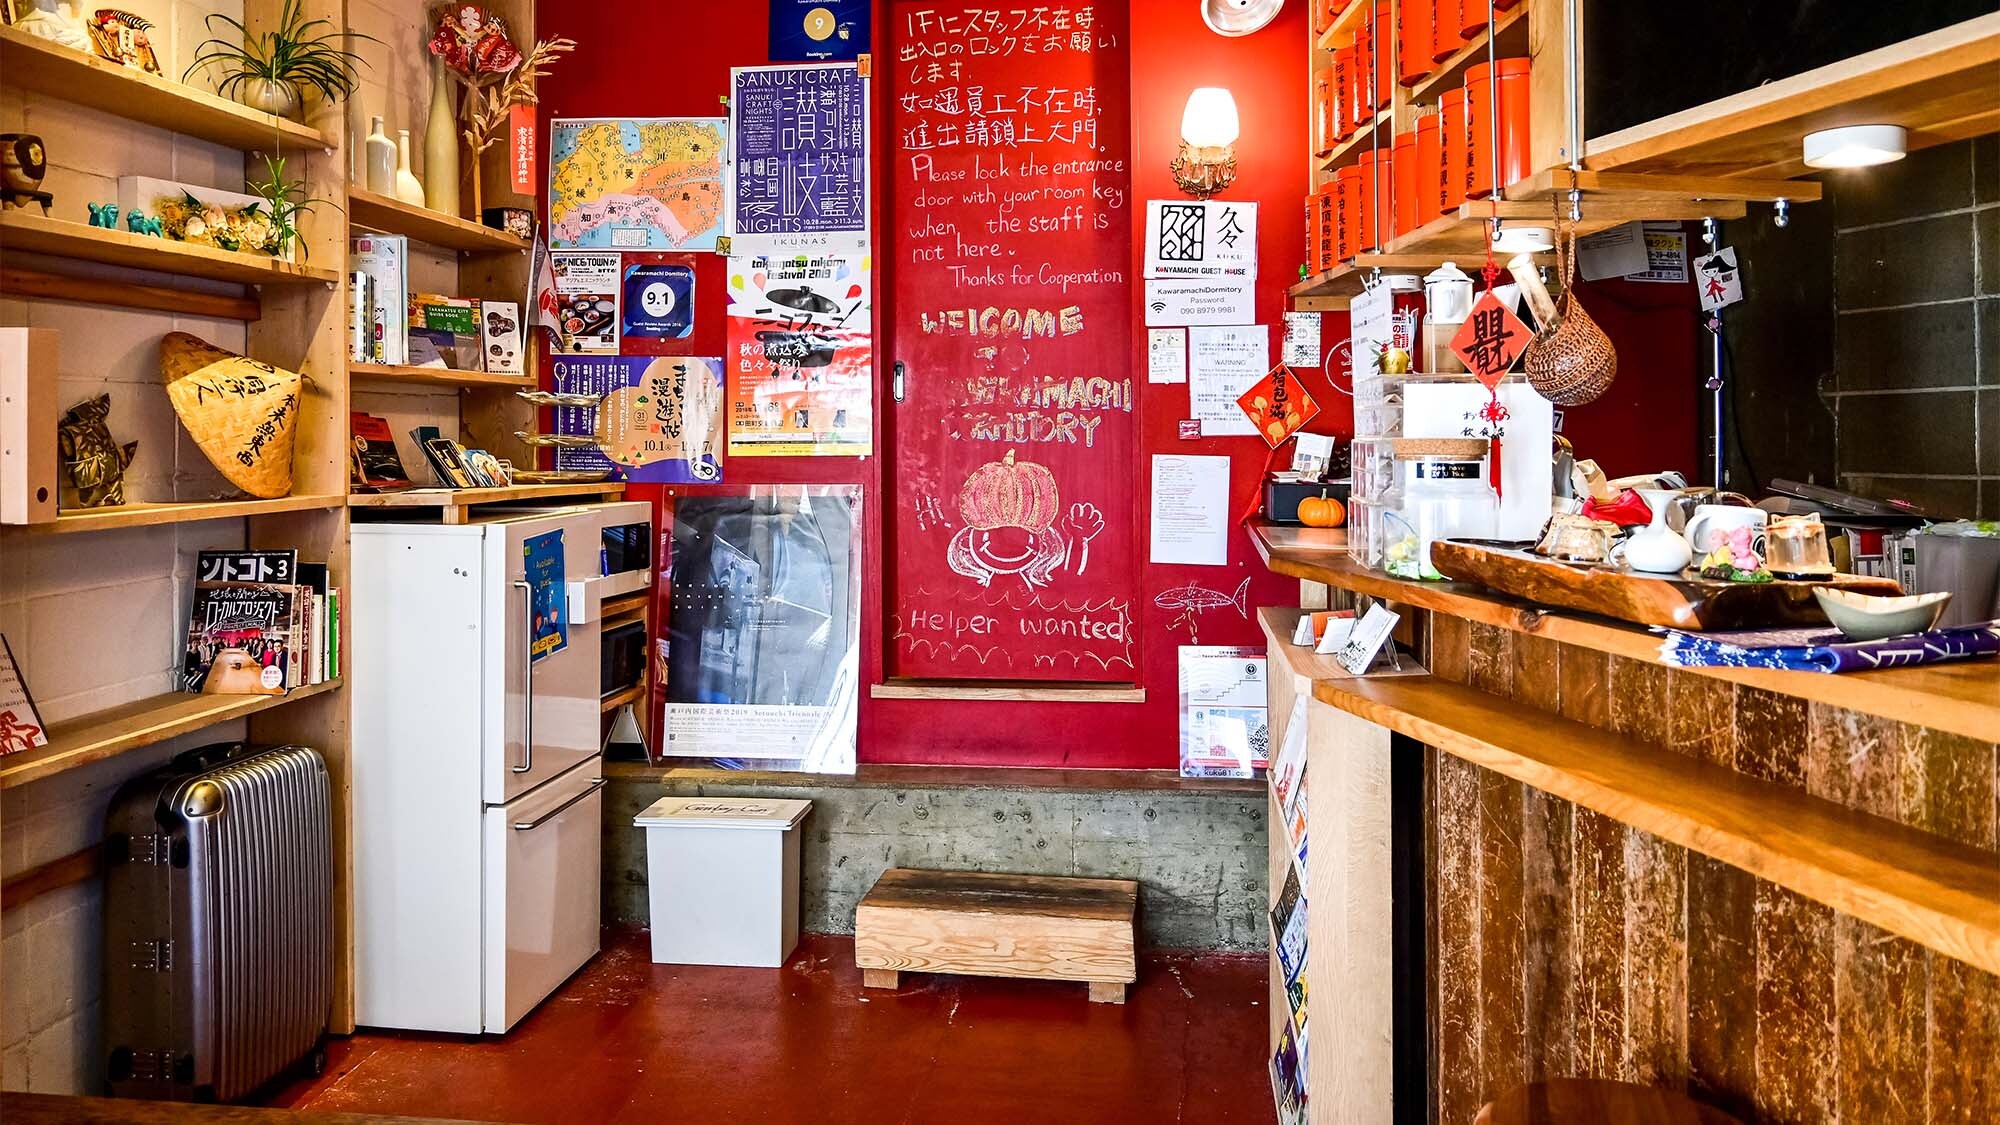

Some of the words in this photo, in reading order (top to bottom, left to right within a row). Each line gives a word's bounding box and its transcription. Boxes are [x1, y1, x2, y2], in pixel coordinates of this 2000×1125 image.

[815, 17, 824, 30] 9
[911, 153, 966, 182] Please
[975, 154, 1010, 180] lock
[1020, 152, 1049, 177] the
[1053, 157, 1124, 175] entrance
[914, 189, 954, 208] door
[962, 184, 996, 203] with
[1003, 189, 1042, 214] your
[1043, 187, 1085, 202] room
[1092, 178, 1123, 209] key
[581, 213, 591, 223] 知
[737, 217, 801, 233] NIGHTS
[910, 214, 957, 237] when
[986, 207, 1021, 234] the
[1028, 206, 1084, 231] staff
[1093, 212, 1109, 230] is
[1216, 207, 1245, 249] 久々
[774, 237, 827, 245] IKUNAS
[912, 245, 945, 263] not
[752, 258, 808, 270] takamatsu
[767, 270, 806, 280] festival
[809, 269, 831, 279] 2019
[946, 264, 1005, 288] Thanks
[1009, 264, 1034, 286] for
[1038, 262, 1123, 293] Cooperation
[647, 291, 669, 305] 9.1
[1158, 286, 1242, 295] KawaramachiDormitory
[739, 343, 809, 357] 秋の煮込み
[202, 557, 273, 582] ソトコト
[277, 559, 288, 578] 3
[205, 601, 279, 632] ローカルプロジェクト
[911, 609, 1000, 639] Helper
[1020, 612, 1124, 641] wanted
